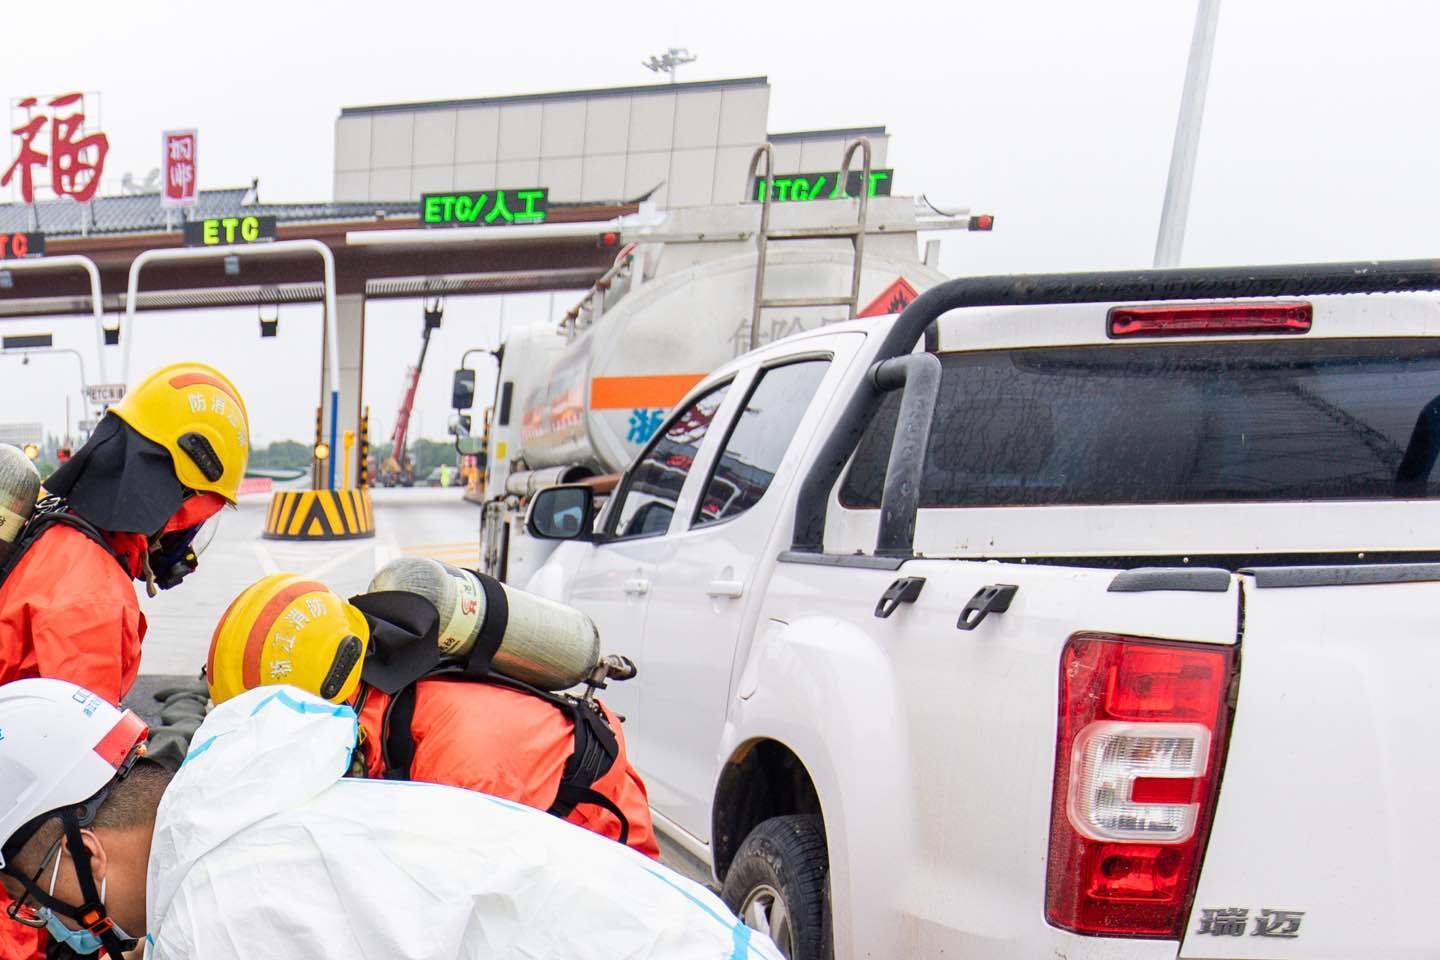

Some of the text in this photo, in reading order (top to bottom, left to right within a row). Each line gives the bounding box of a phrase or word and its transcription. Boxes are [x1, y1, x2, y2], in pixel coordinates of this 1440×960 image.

[424, 190, 545, 223] ETC/人工
[203, 216, 259, 245] ETC
[728, 316, 848, 359] 危险
[1198, 907, 1306, 939] 瑞迈
